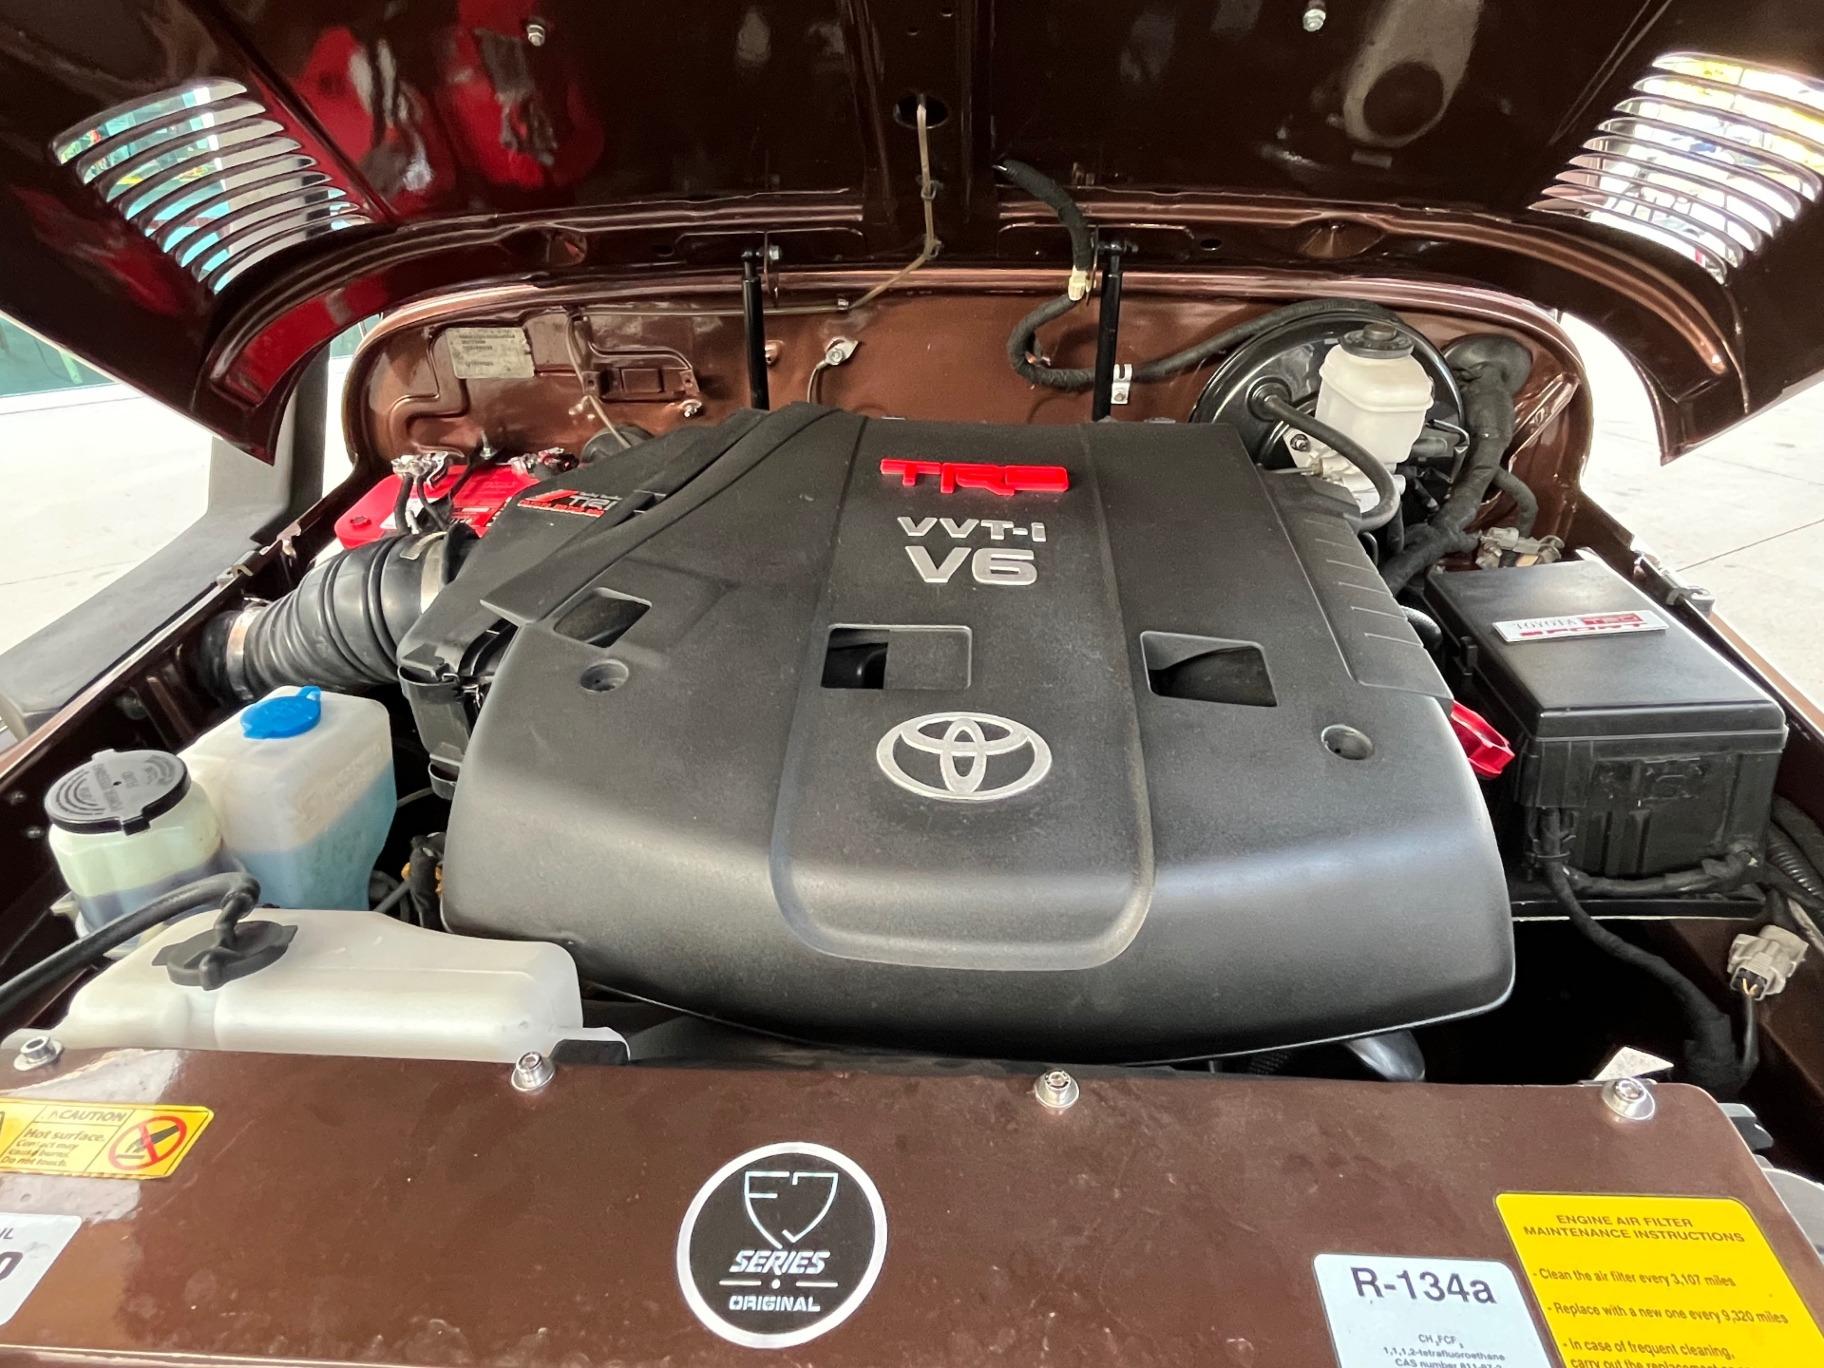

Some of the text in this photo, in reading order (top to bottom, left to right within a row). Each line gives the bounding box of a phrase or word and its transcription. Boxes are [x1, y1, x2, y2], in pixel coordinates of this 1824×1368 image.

[880, 458, 1070, 496] TRD
[905, 545, 1038, 586] V6
[58, 1109, 128, 1122] CAUTION
[23, 1128, 51, 1139] Hot
[1556, 1215, 1694, 1228] ENGINE AIR FILTER
[1523, 1226, 1745, 1243] MAINTENANCE INSTRUCTIONS
[729, 1250, 831, 1275] SERIES
[1350, 1267, 1498, 1304] R-134a
[1539, 1268, 1736, 1287] Clean the air filter every 3,107 miles
[729, 1295, 821, 1312] ORIGINAL
[1553, 1302, 1789, 1324] Replace with a new one every 9,320 miles
[1568, 1338, 1736, 1360] In case of frequent cleaning,
[1394, 1358, 1418, 1368] CAS
